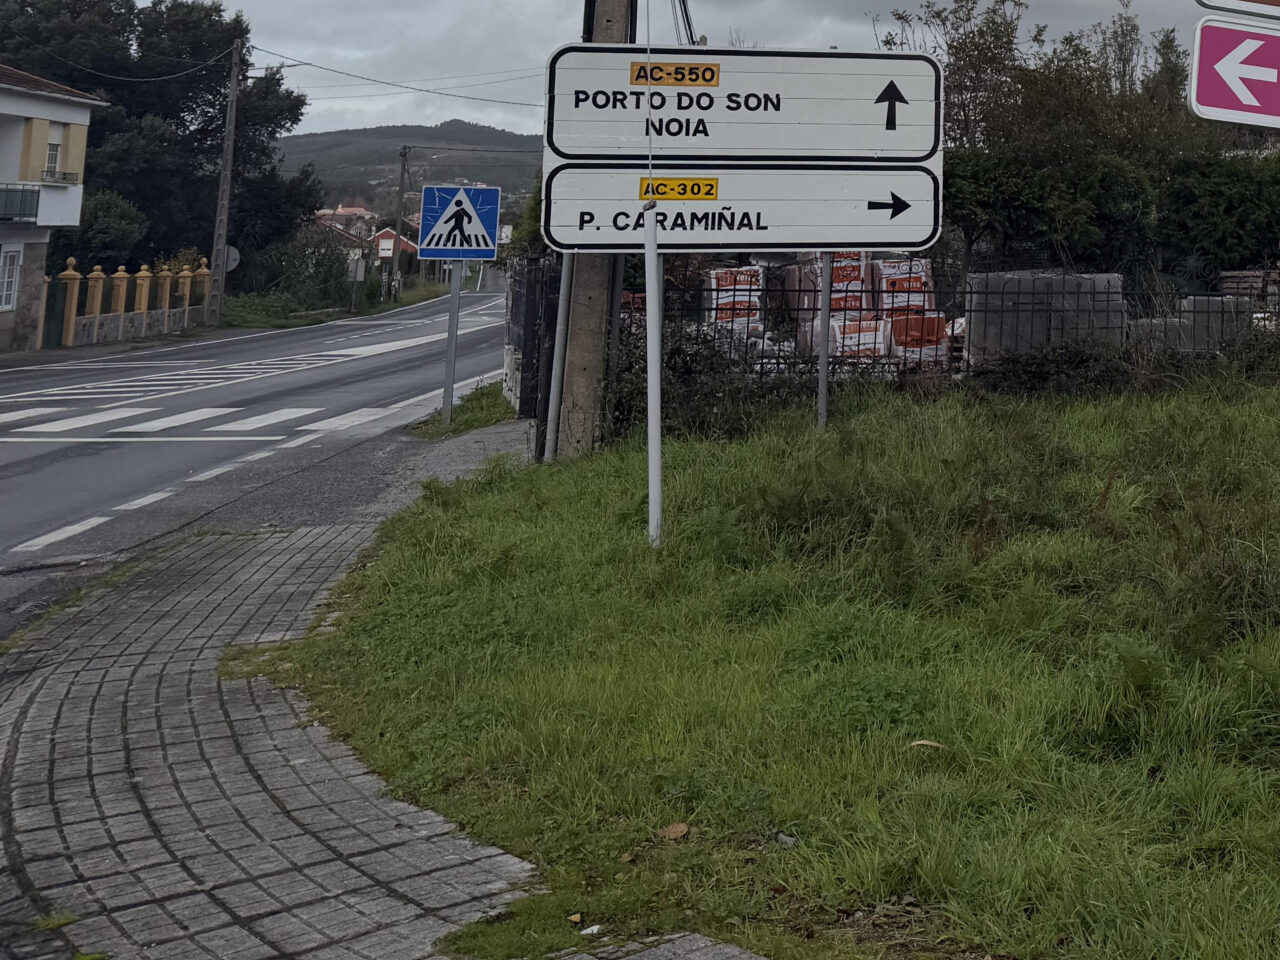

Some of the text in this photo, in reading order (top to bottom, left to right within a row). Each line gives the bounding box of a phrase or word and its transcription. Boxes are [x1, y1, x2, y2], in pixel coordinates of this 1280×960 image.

[634, 66, 716, 83] AC-550
[574, 90, 781, 112] PORTO DO SON
[644, 118, 709, 137] NOIA
[643, 182, 716, 197] AC-302
[578, 211, 600, 231] P.
